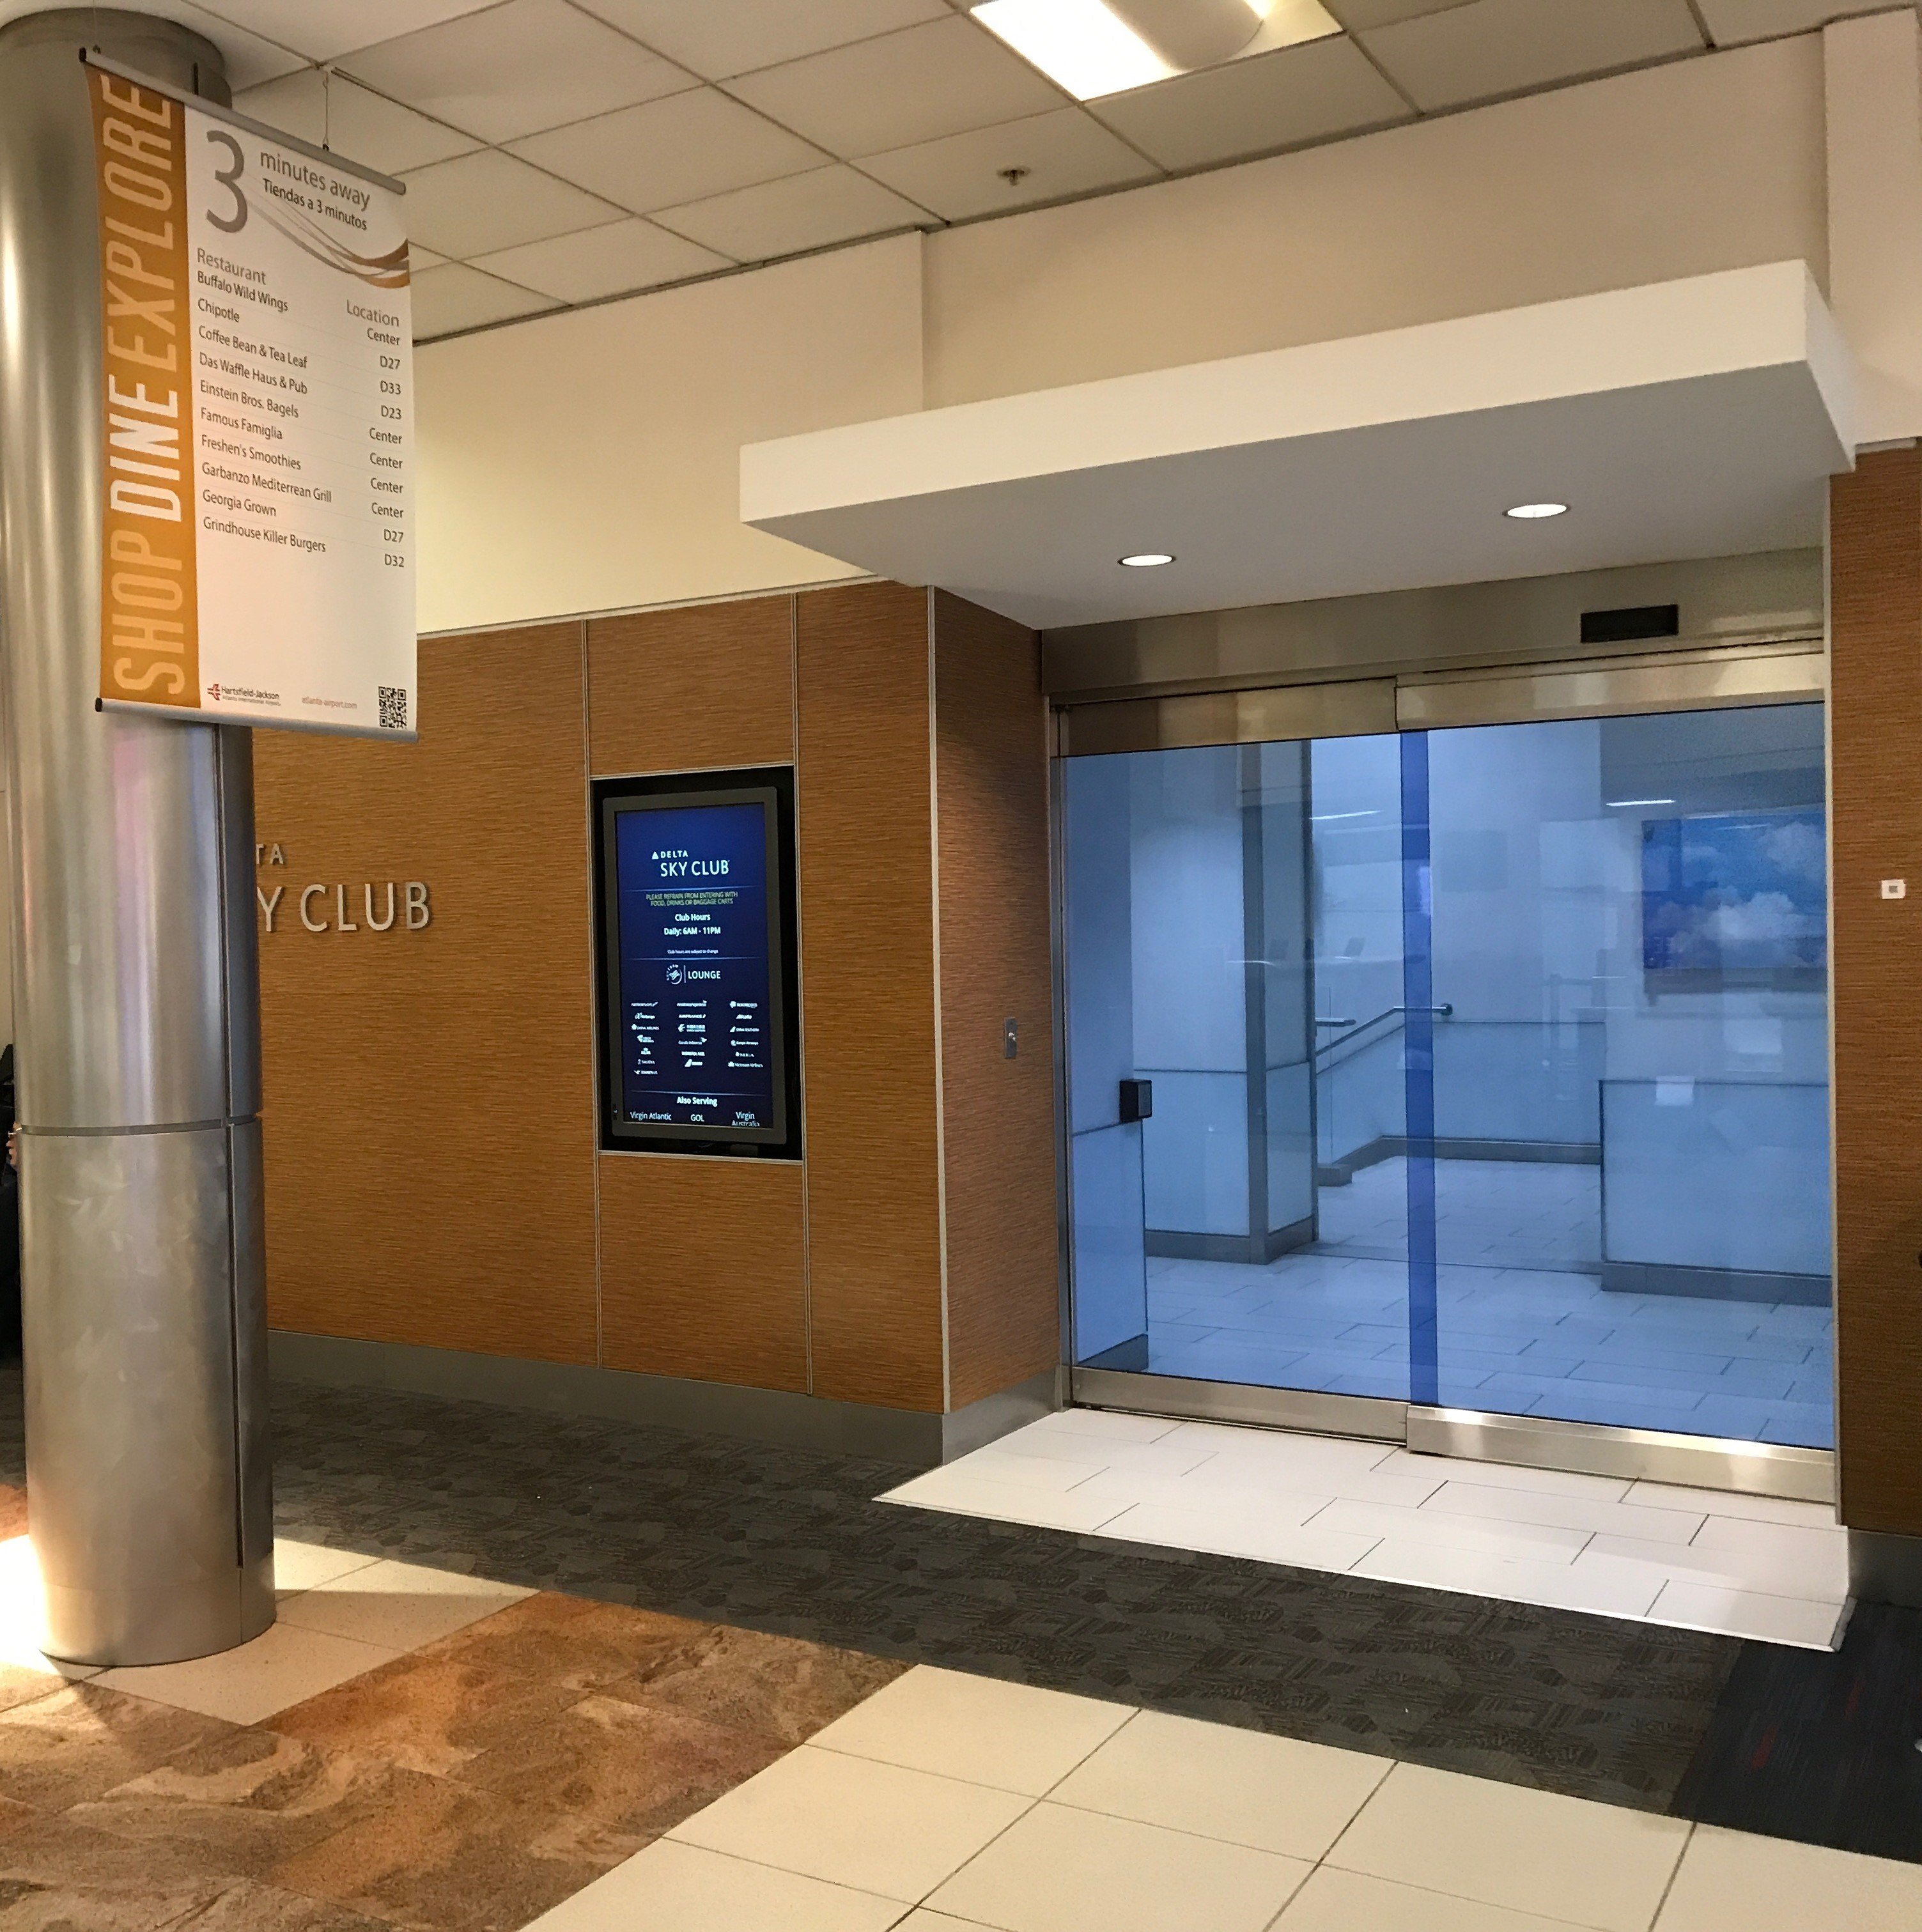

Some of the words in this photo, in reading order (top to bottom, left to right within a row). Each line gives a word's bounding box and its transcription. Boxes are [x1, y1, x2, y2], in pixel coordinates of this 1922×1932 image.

[206, 130, 247, 233] 3
[261, 151, 326, 190] minutes
[330, 180, 371, 212] away
[263, 178, 305, 207] Tiendas
[307, 198, 314, 210] a
[316, 199, 323, 213] 3
[325, 205, 368, 231] minutos
[100, 73, 177, 373] EXPLORE
[197, 247, 267, 285] Restaurant
[198, 270, 232, 294] Buffalo
[234, 282, 256, 301] Wild
[257, 291, 288, 313] Wings
[198, 298, 240, 323] Chipotle
[346, 298, 399, 327] Location
[199, 325, 230, 346] Coffee
[233, 336, 257, 354] Bean
[259, 344, 267, 357] &
[268, 346, 285, 362] Tea
[288, 352, 307, 369] Leaf
[366, 327, 400, 346] Center
[199, 352, 218, 369] Das
[220, 359, 250, 378] Waffle
[252, 370, 277, 386] Haus
[279, 376, 286, 389] &
[289, 378, 307, 394] Pub
[380, 355, 401, 370] D27
[200, 380, 238, 402] Einstein
[241, 392, 265, 409] Bros.
[267, 398, 299, 418] Bagels
[380, 380, 401, 395] D33
[201, 406, 239, 429] Famous
[242, 418, 283, 440] Famiglia
[381, 405, 402, 420] D23
[108, 373, 182, 522] DINE
[369, 427, 403, 445] Center
[201, 434, 247, 458] Freshen's
[249, 447, 301, 470] Smoothies
[369, 452, 403, 469] Center
[202, 461, 250, 484] Garbanzo
[252, 474, 311, 498] Mediterrean
[313, 488, 332, 503] Grill
[370, 477, 404, 494] Center
[203, 489, 242, 510] Georgia
[244, 498, 277, 516] Grown
[371, 502, 404, 518] Center
[203, 516, 261, 540] Grindhouse
[263, 529, 288, 545] Killer
[290, 534, 326, 553] Burgers
[384, 529, 404, 543] D27
[384, 553, 405, 568] D32
[111, 530, 185, 694] SHOP
[256, 843, 284, 864] TA
[661, 850, 688, 858] DELTA
[660, 862, 688, 877] SKY
[692, 860, 729, 876] CLUB
[257, 886, 283, 932] Y
[300, 881, 429, 932] CLUB
[675, 913, 690, 922] Club
[664, 927, 682, 937] Daily:
[688, 970, 721, 979] LOUNGE
[677, 1096, 692, 1104] Also
[692, 1097, 718, 1107] Serving
[630, 1111, 648, 1121] Virgin
[649, 1112, 672, 1120] Atlantic
[736, 1111, 755, 1121] Virgin
